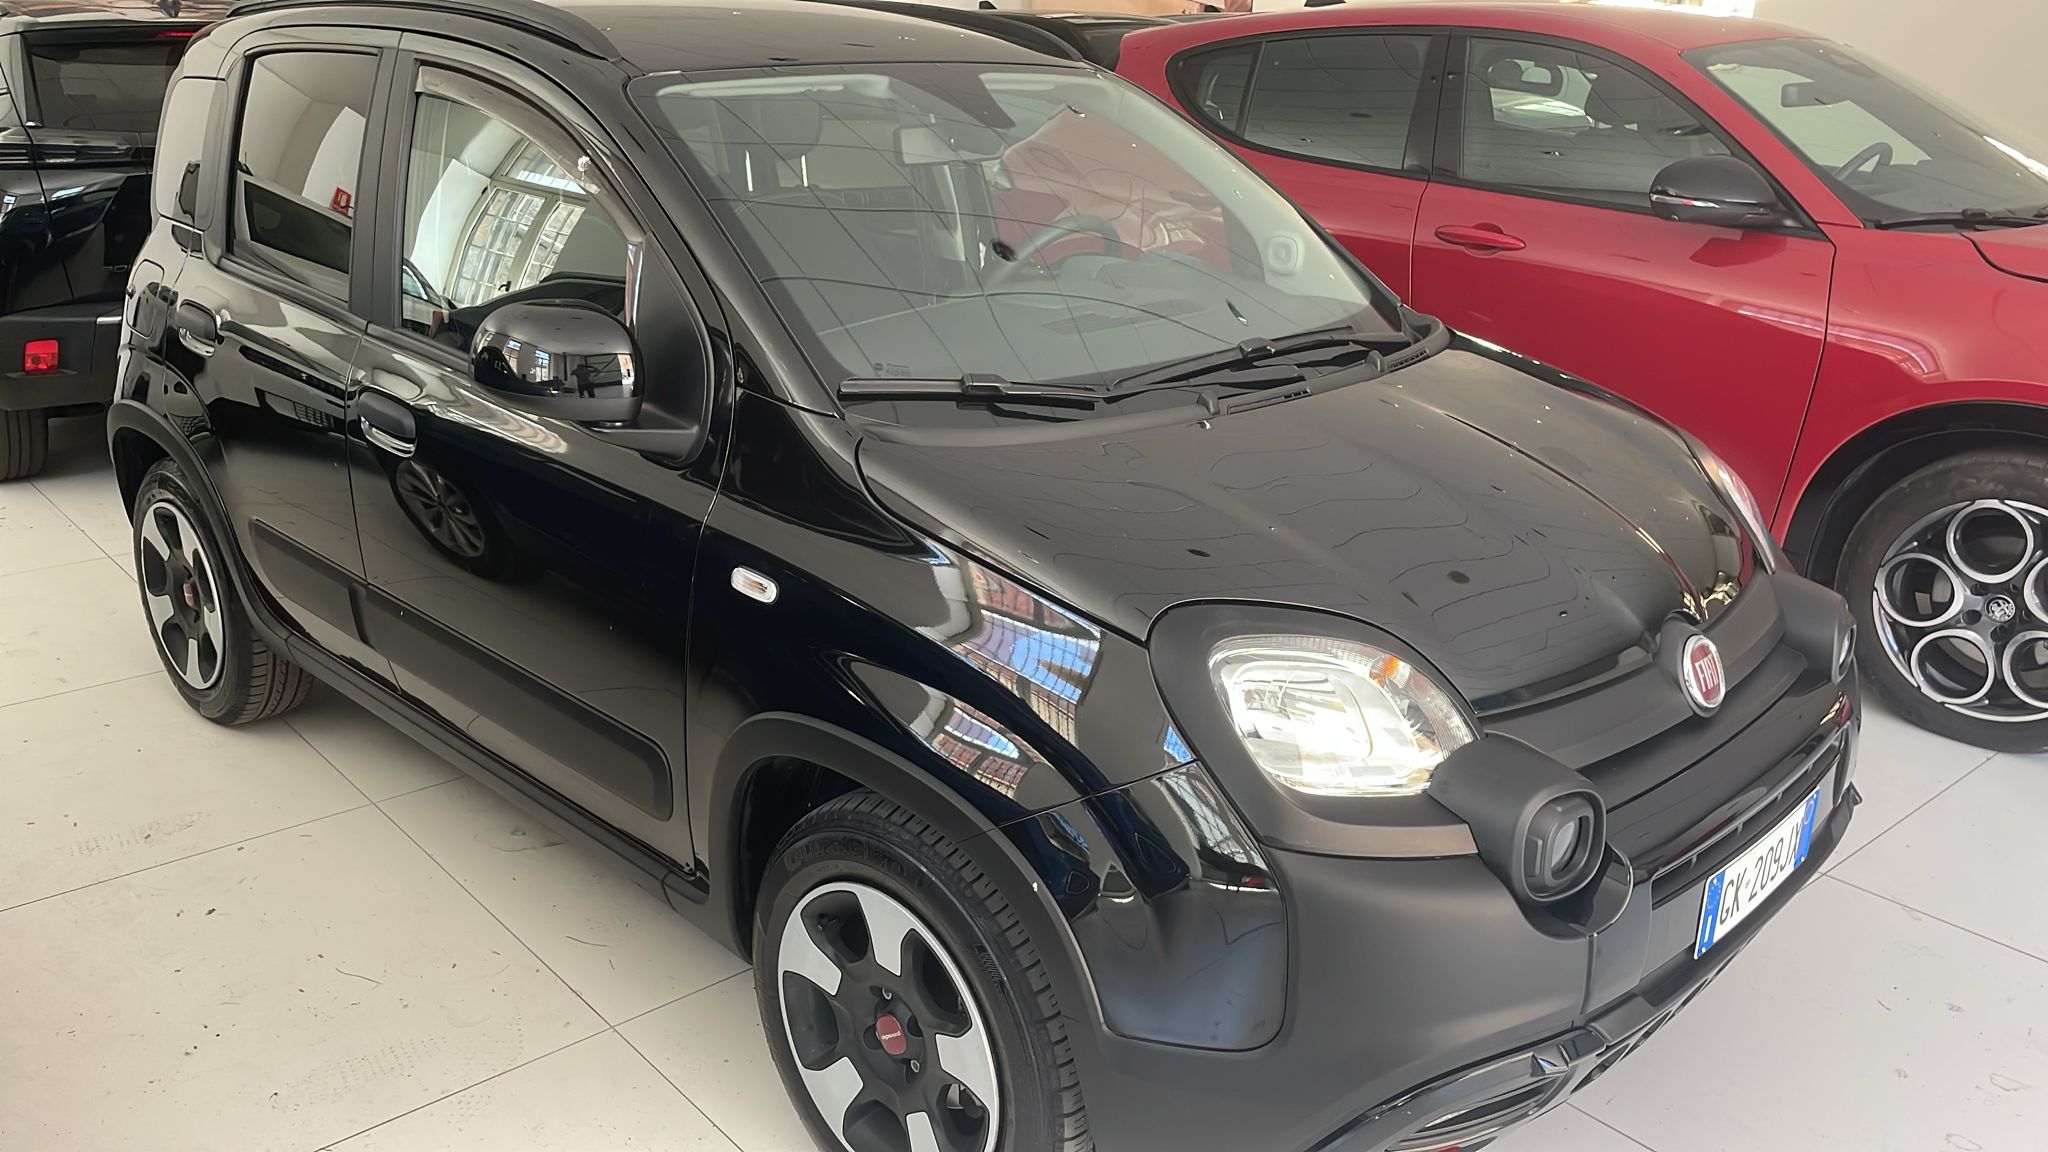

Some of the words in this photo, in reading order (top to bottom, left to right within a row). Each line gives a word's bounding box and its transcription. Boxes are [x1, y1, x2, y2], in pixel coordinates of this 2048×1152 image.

[1694, 652, 1719, 693] FIAT
[1719, 866, 1748, 926] GK
[1748, 816, 1804, 903] 209JX
